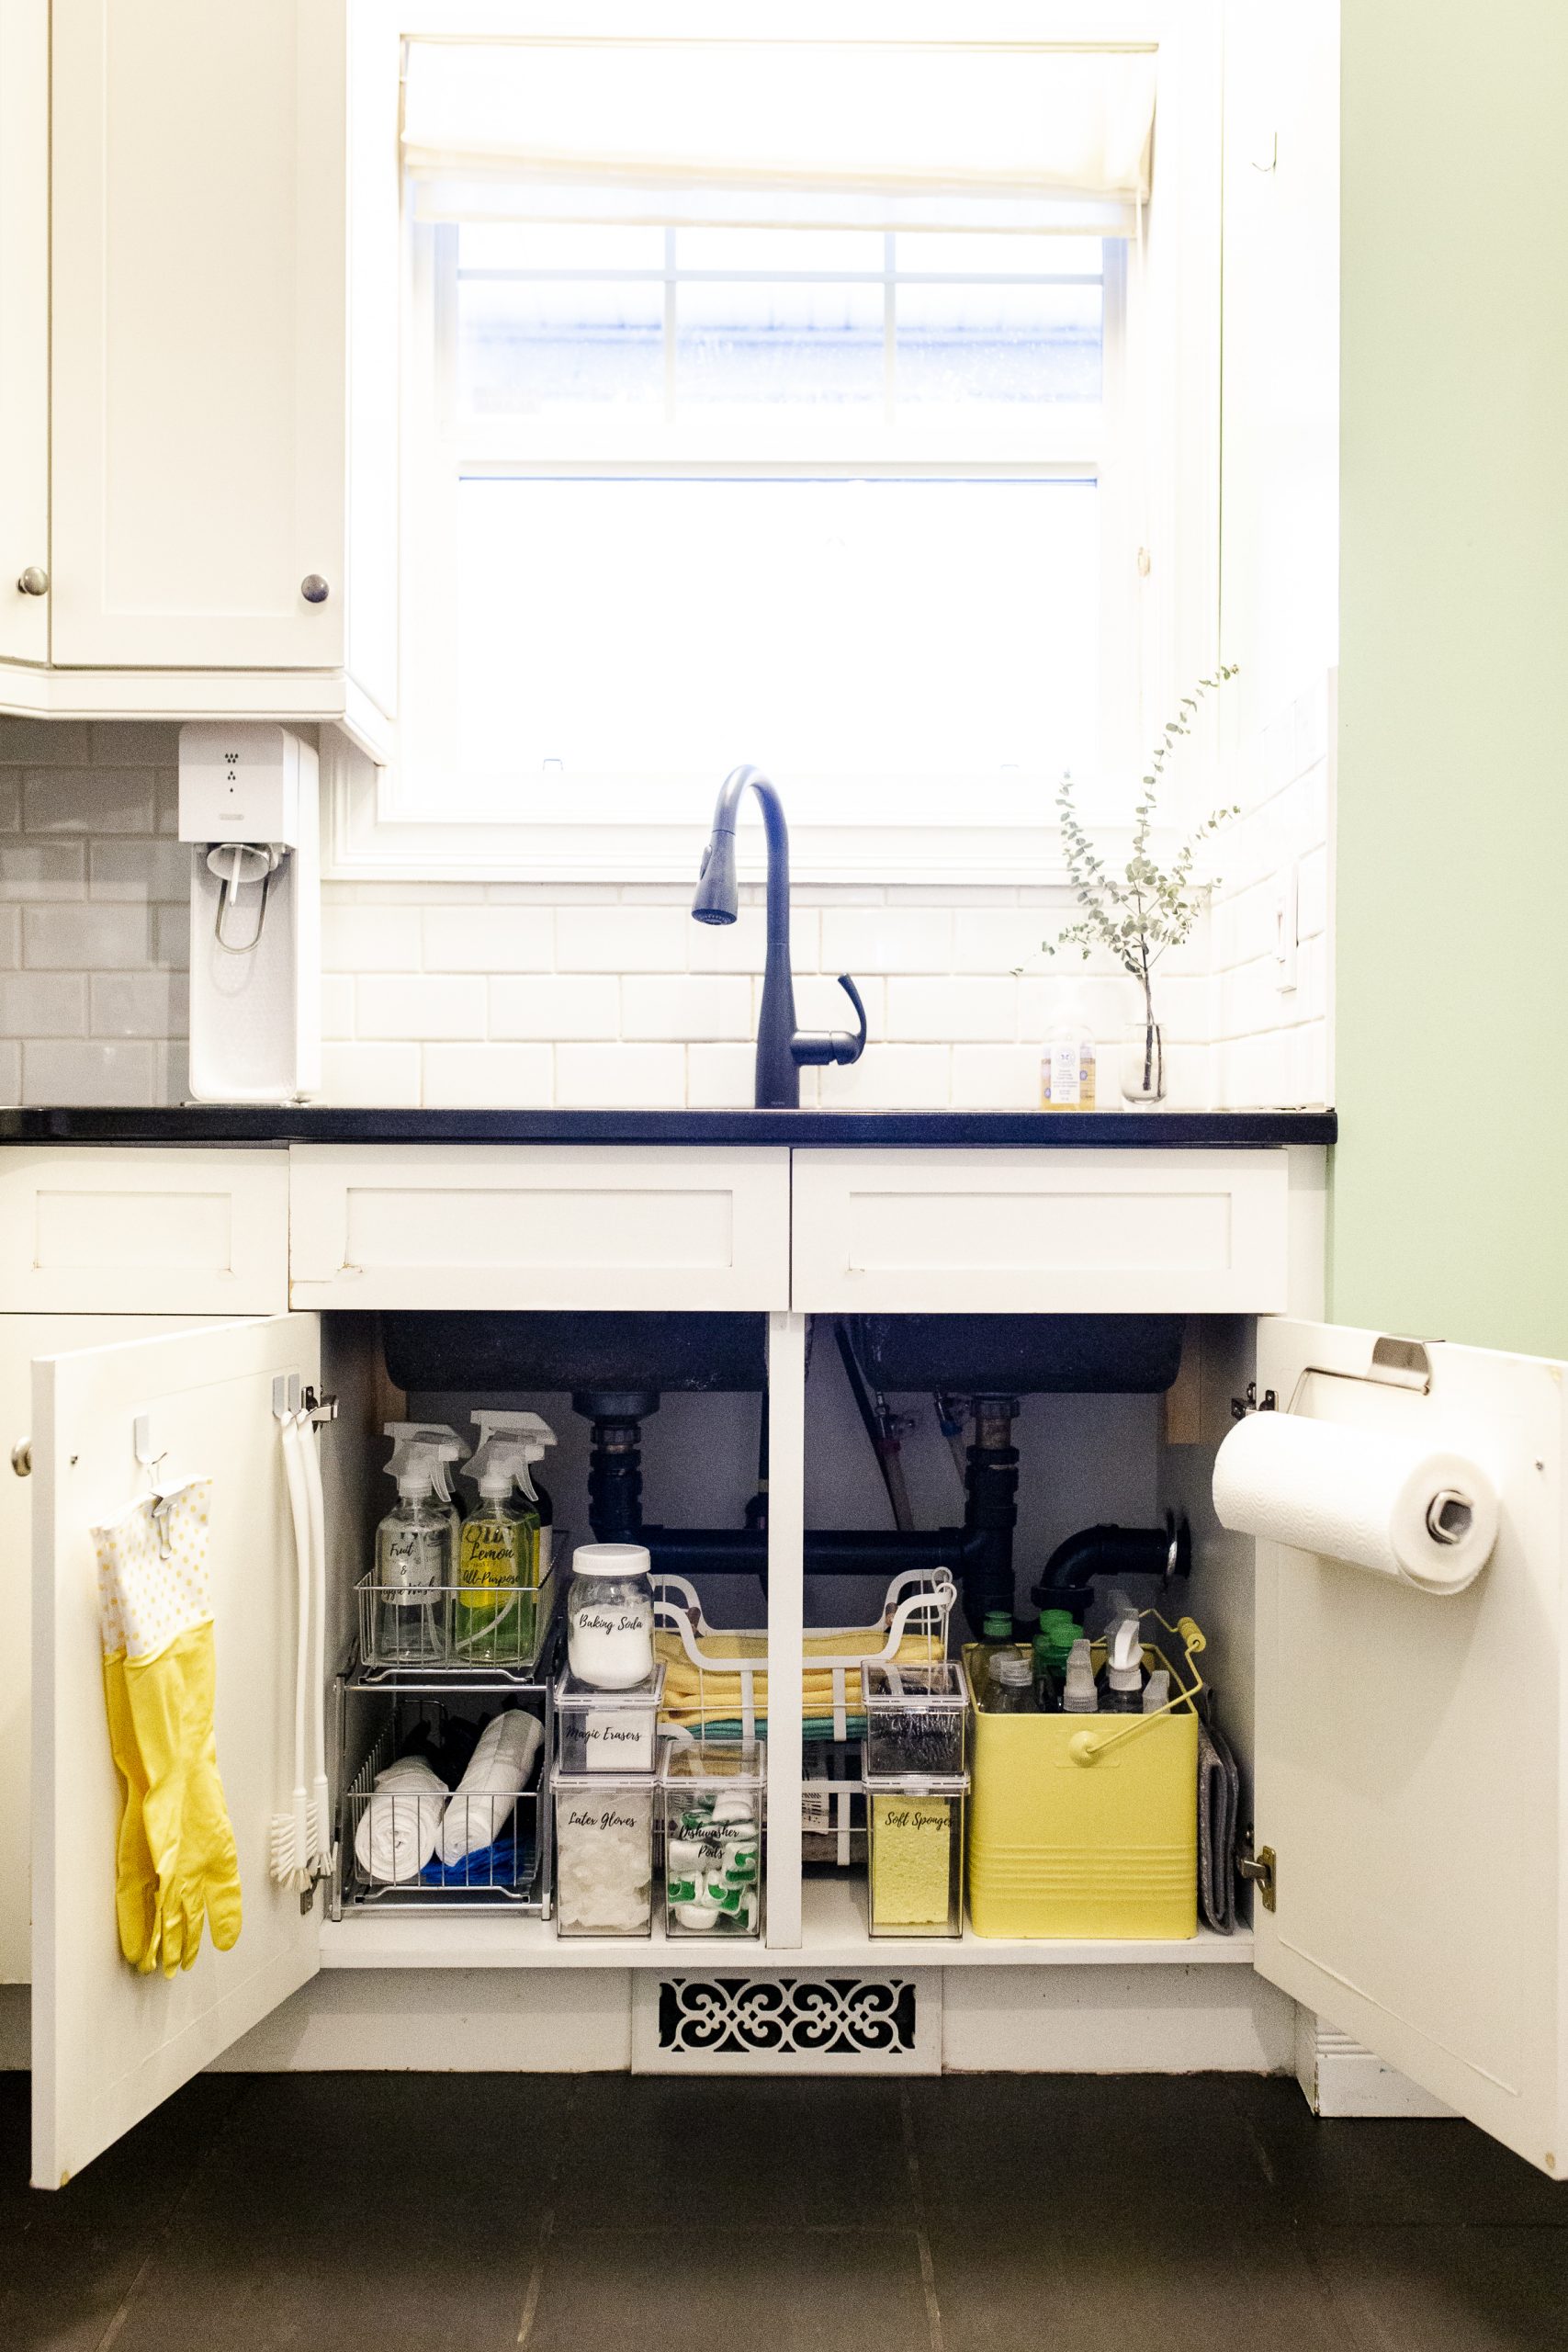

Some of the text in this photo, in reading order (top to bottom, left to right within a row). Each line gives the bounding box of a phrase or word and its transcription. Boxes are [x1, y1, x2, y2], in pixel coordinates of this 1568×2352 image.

[389, 1541, 414, 1557] Fruit
[469, 1542, 514, 1561] Lemon
[400, 1565, 408, 1577] &
[463, 1568, 521, 1587] All-Purpose
[579, 1613, 644, 1634] Baking Soda
[565, 1724, 642, 1745] Magic Erasers
[568, 1810, 637, 1831] Latex Gloves
[676, 1819, 740, 1840] Dishwasher
[885, 1811, 953, 1831] Soft Sponges
[697, 1844, 726, 1860] Pods
